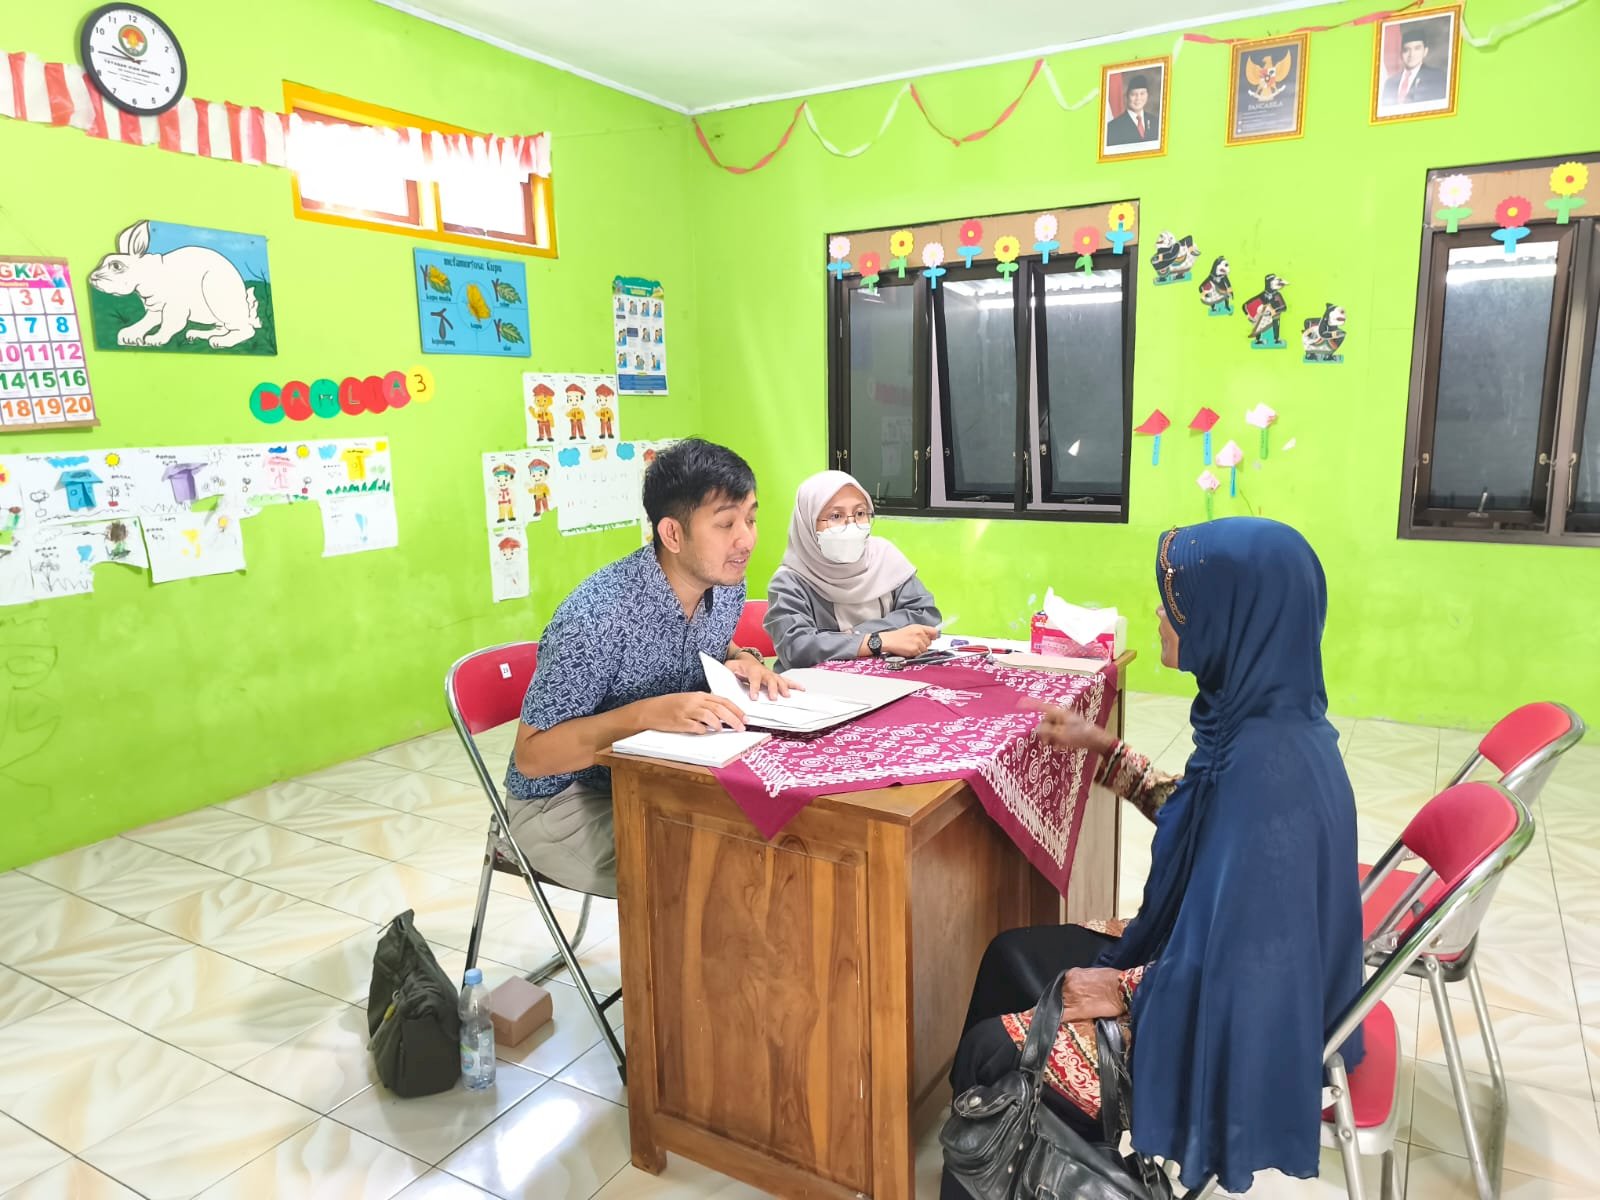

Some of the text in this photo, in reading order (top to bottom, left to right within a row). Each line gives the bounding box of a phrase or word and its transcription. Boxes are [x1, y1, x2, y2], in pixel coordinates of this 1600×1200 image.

[108, 16, 117, 24] 11
[128, 15, 138, 23] 12
[95, 27, 105, 35] 10
[19, 289, 65, 306] 3 4
[24, 317, 37, 333] 7
[56, 316, 69, 333] 8
[24, 344, 49, 361] 11
[55, 343, 82, 360] 12
[0, 370, 87, 390] 14 15 16
[414, 374, 427, 392] 3
[3, 396, 92, 417] 18 19 20
